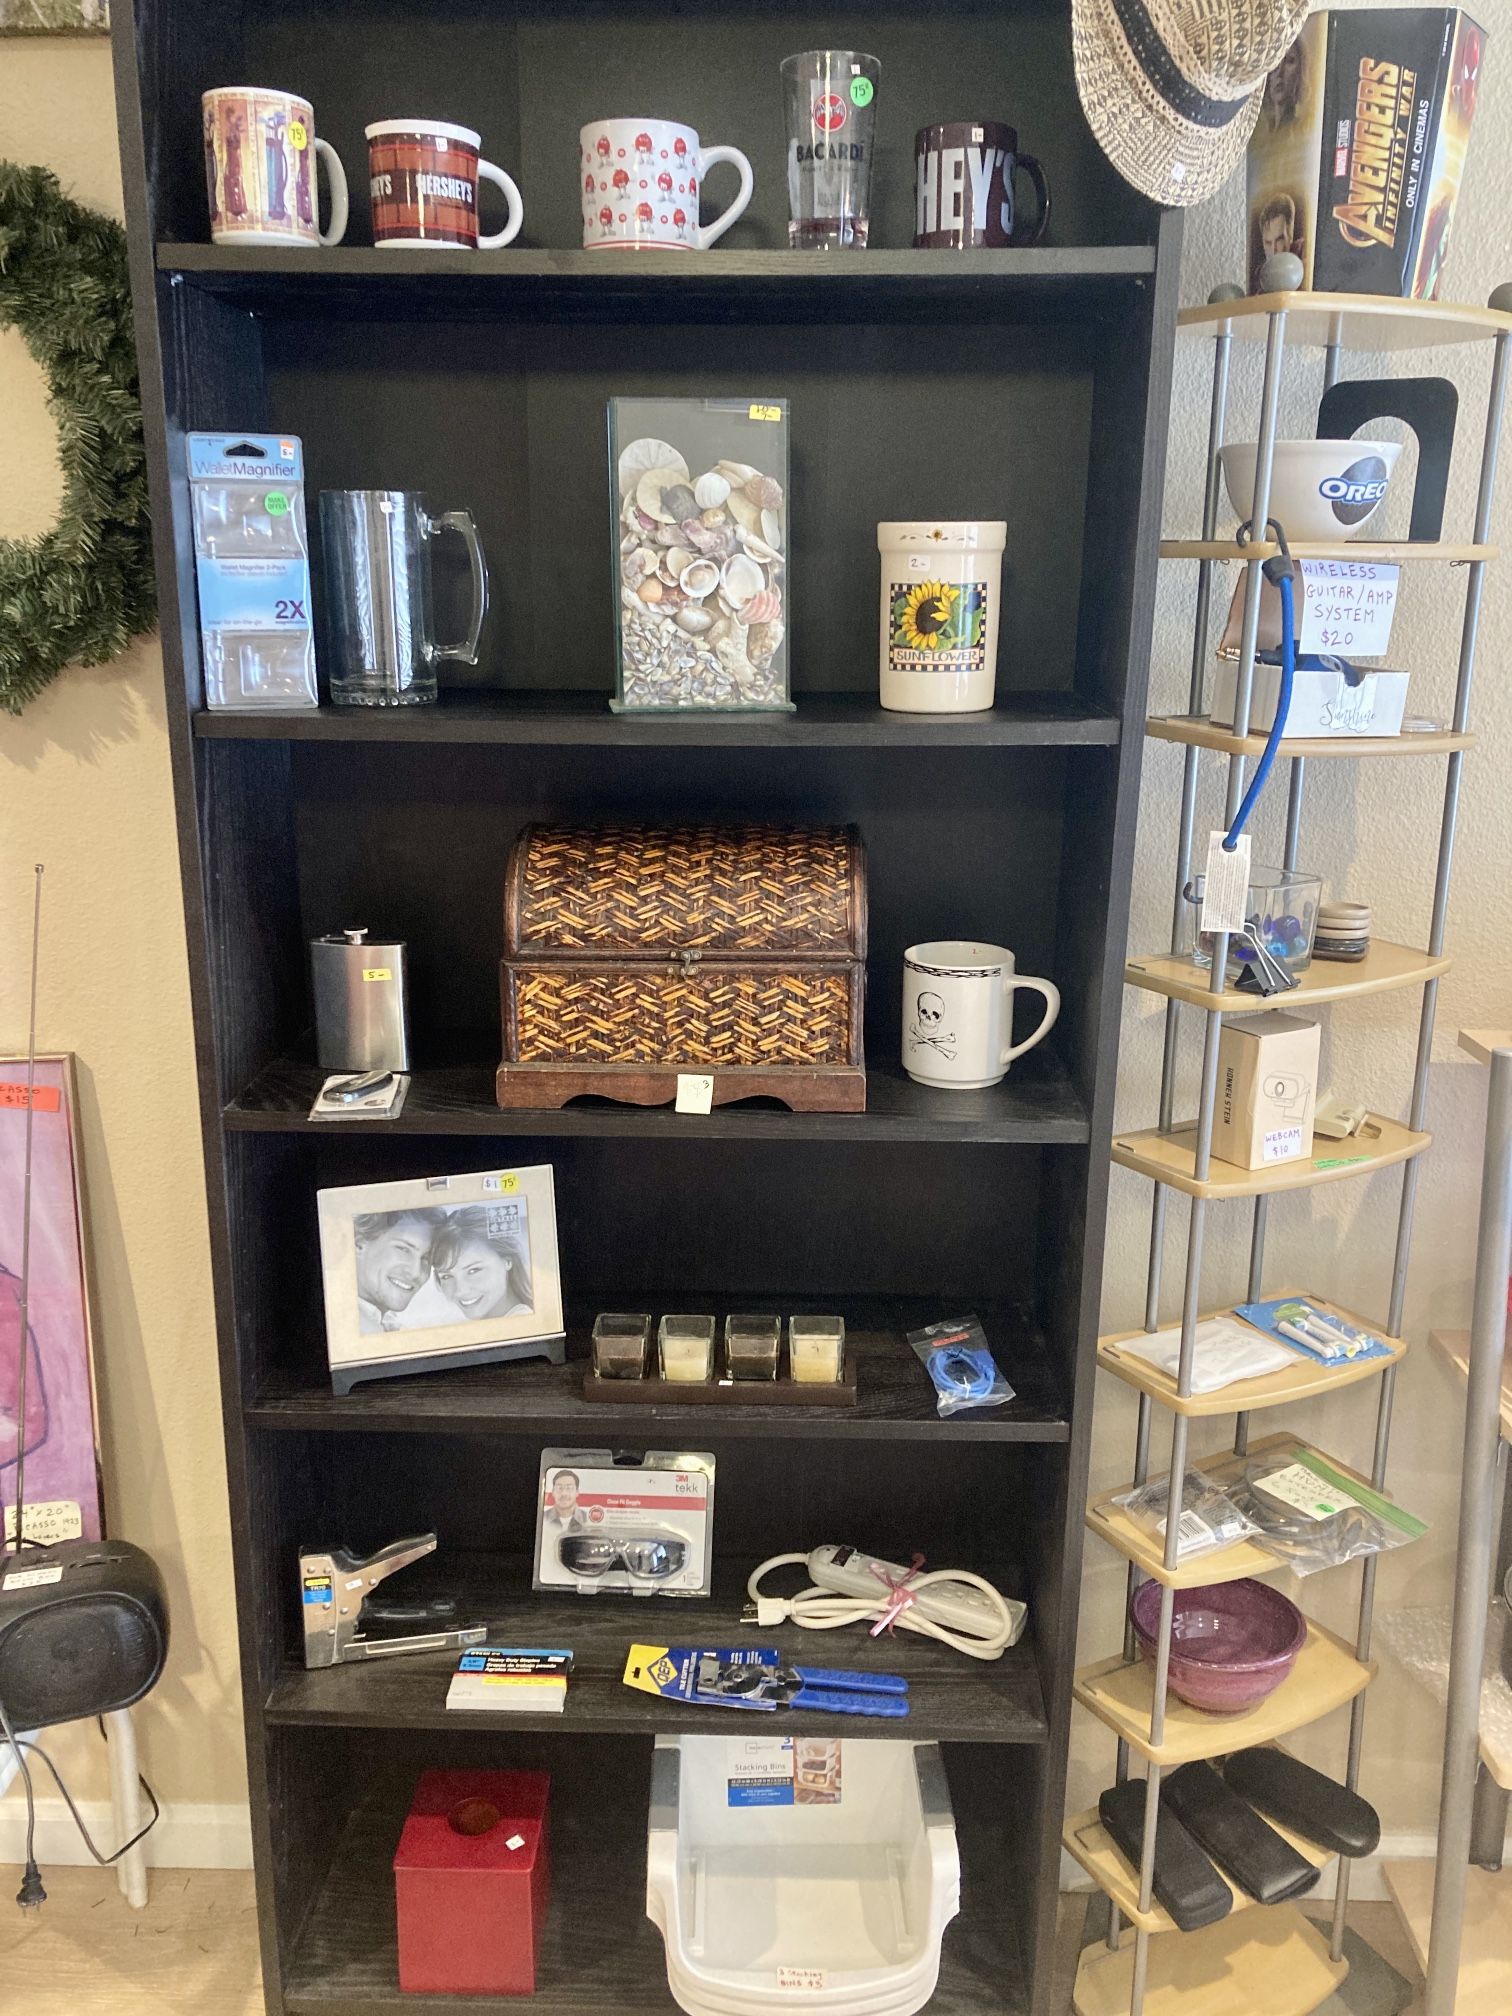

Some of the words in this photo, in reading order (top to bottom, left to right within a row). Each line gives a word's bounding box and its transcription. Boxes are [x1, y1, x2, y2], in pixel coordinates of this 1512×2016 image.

[1337, 120, 1349, 148] STUDIOS
[1414, 100, 1430, 151] CINEMAS
[1333, 57, 1400, 249] AVENGERS
[1384, 127, 1407, 230] INFINITY
[1399, 69, 1415, 116] WAR
[1411, 159, 1421, 171] IN
[415, 173, 473, 203] HERSHEY'S
[1406, 177, 1419, 208] ONLY
[1319, 478, 1388, 503] OREO
[1302, 562, 1377, 580] WIRELESS
[275, 600, 306, 619] 2X
[1314, 603, 1375, 623] SYSTEM
[1321, 628, 1353, 646] $20
[896, 650, 978, 662] SUNFLOWER
[1223, 1101, 1232, 1125] STEIN
[1265, 1128, 1300, 1142] WEBCAM
[1272, 1144, 1289, 1157] $10
[675, 1475, 689, 1483] 3M
[675, 1483, 698, 1494] tekk
[657, 1658, 670, 1682] QEP
[735, 1763, 768, 1772] Stacking
